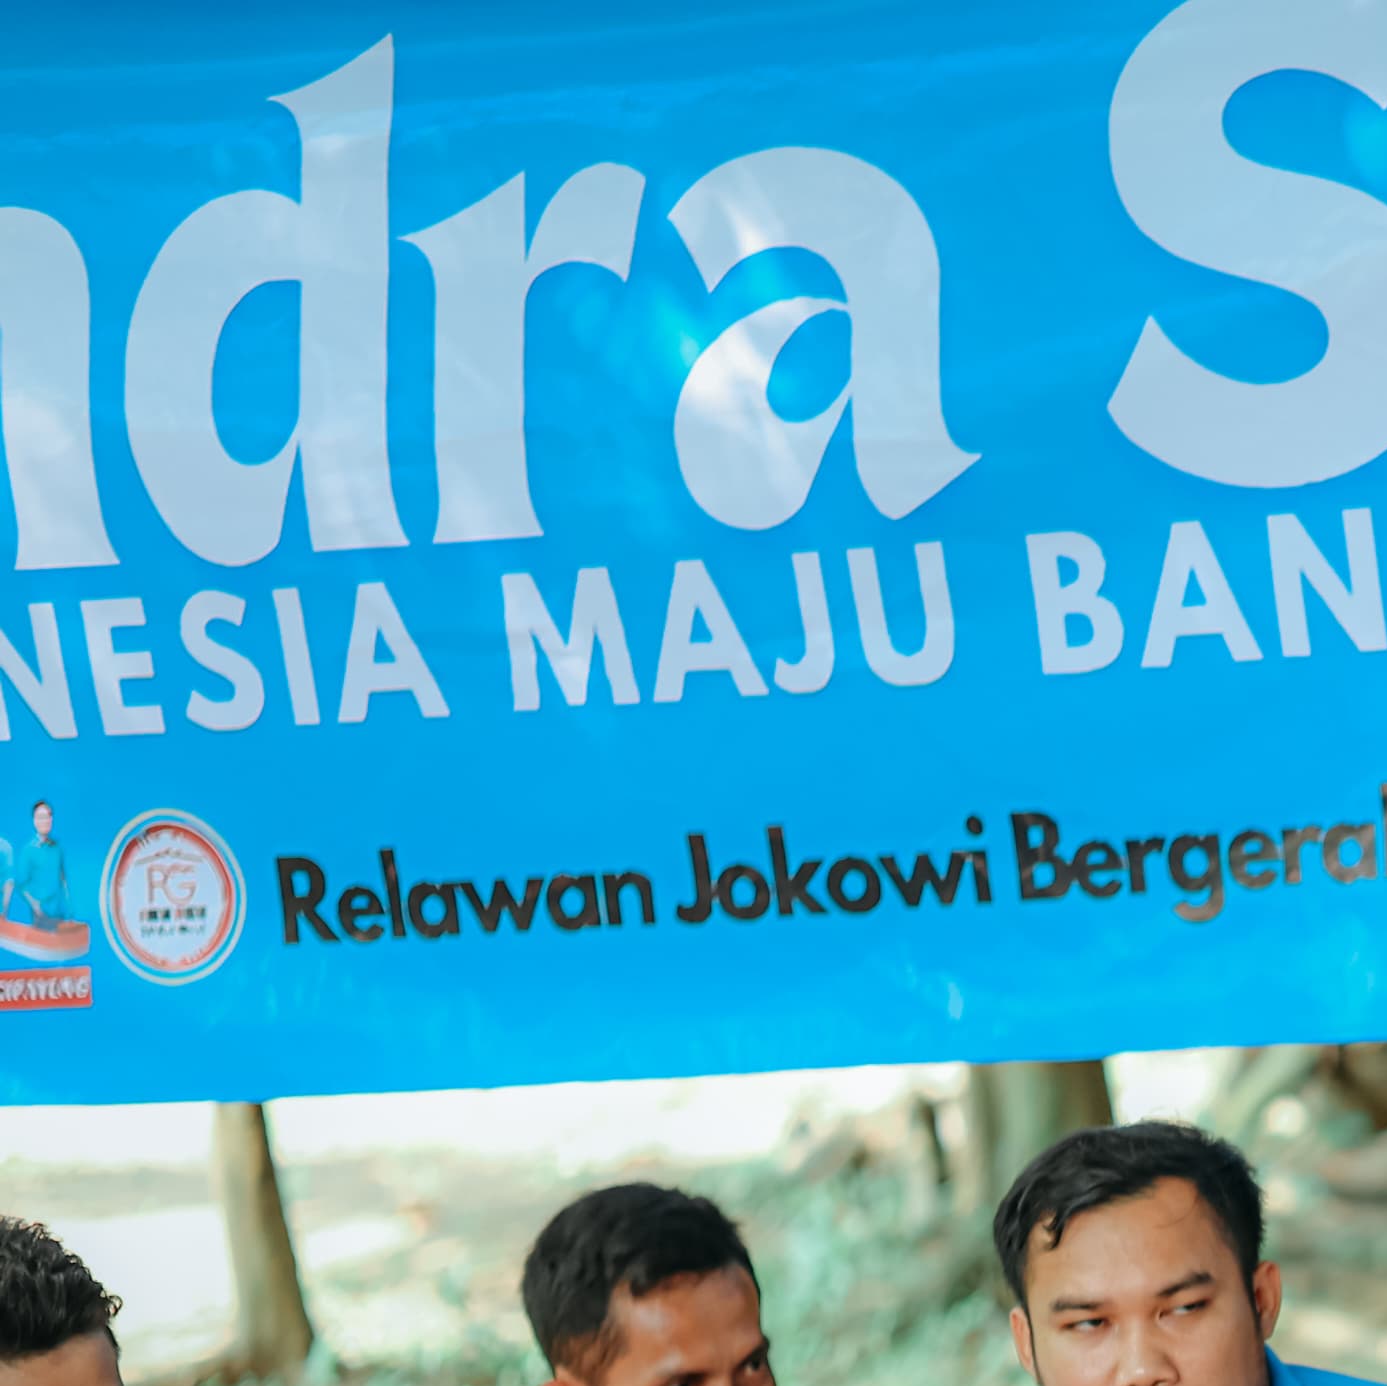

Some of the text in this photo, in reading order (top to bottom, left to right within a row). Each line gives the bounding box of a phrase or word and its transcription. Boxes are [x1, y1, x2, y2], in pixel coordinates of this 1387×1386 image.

[502, 541, 954, 711] MAJU
[277, 847, 654, 945] Relawan
[677, 816, 993, 924] Jokowi
